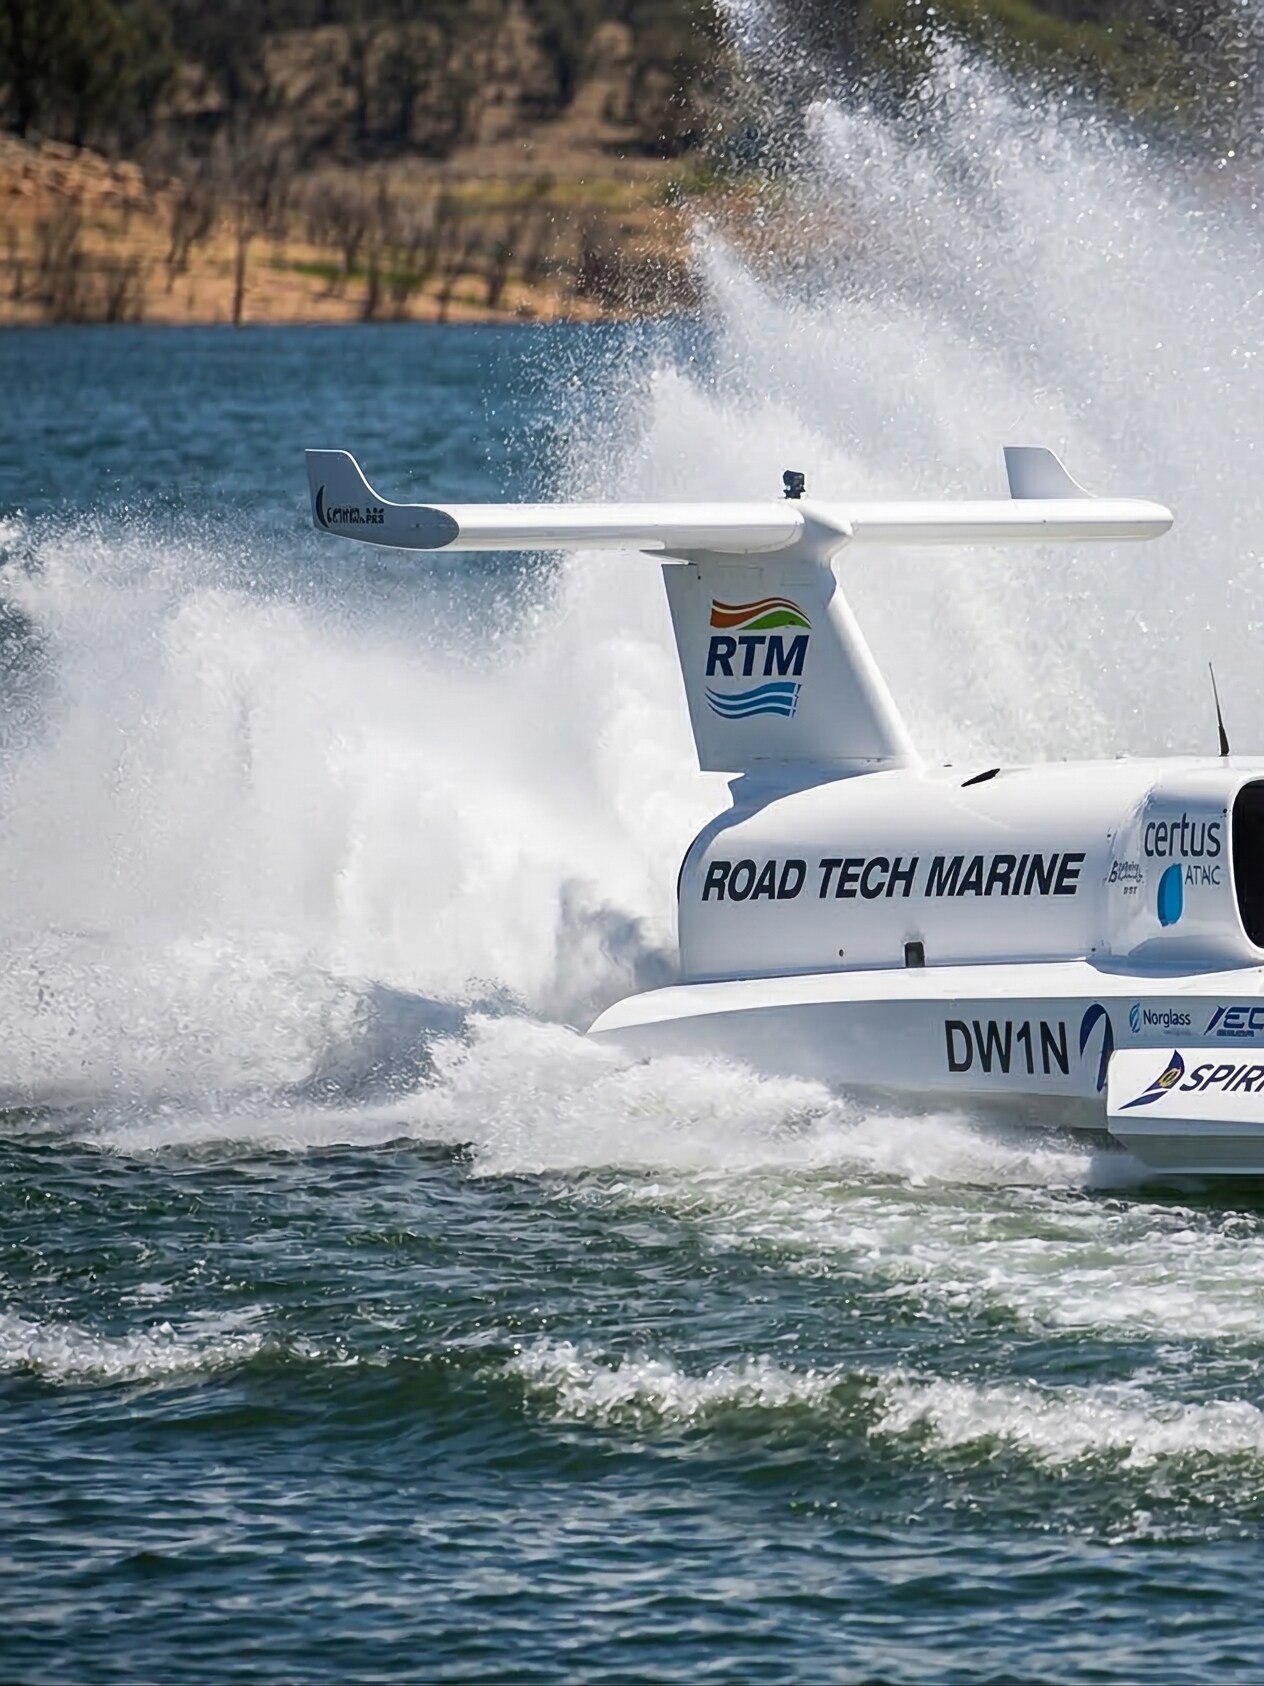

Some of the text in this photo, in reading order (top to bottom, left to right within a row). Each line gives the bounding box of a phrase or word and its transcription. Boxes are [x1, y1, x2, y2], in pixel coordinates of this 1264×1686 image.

[705, 635, 809, 676] RTM
[1144, 812, 1221, 857] certus
[701, 859, 807, 901] ROAD
[817, 856, 919, 900] TECH
[925, 853, 1086, 898] MARINE
[1143, 1008, 1191, 1028] Norglass
[945, 1020, 1070, 1075] DW1N
